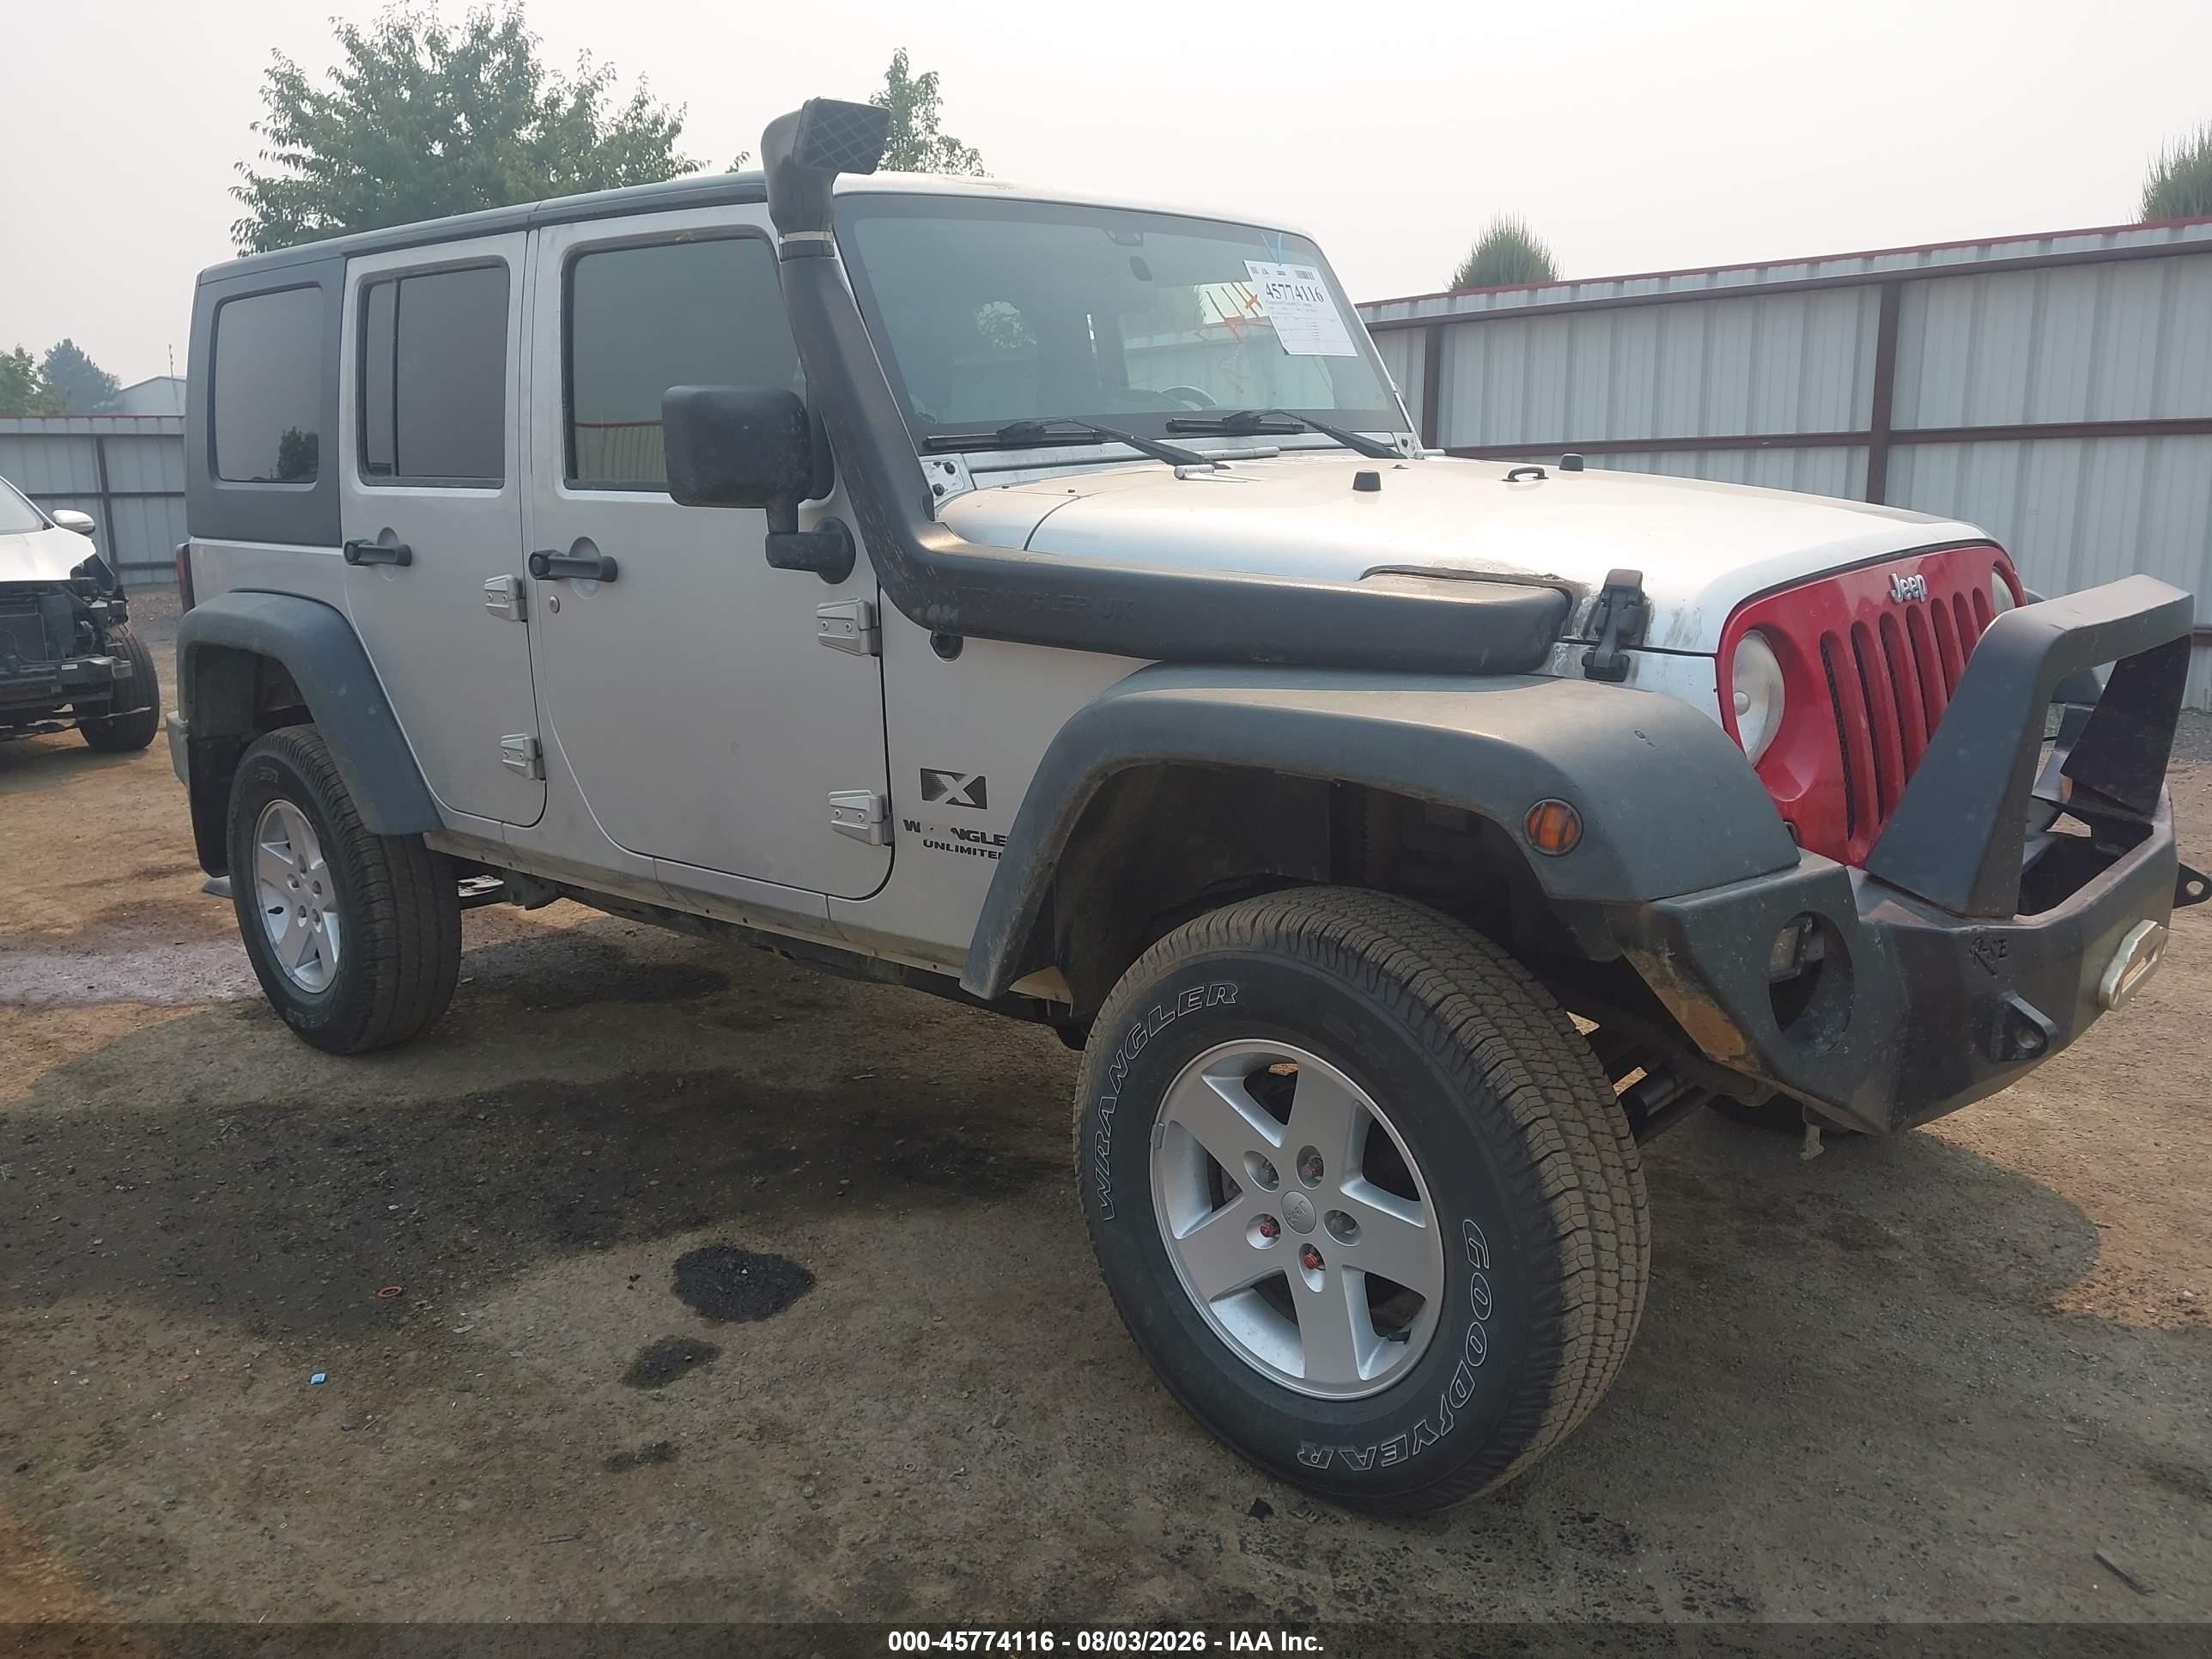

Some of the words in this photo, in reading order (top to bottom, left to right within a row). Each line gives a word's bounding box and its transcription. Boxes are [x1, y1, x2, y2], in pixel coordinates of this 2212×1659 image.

[1265, 282, 1325, 303] 45774116
[1888, 573, 1928, 605] Jeep
[1088, 981, 1239, 1223] WRANGLER
[1297, 1218, 1494, 1472] GOODYEAR
